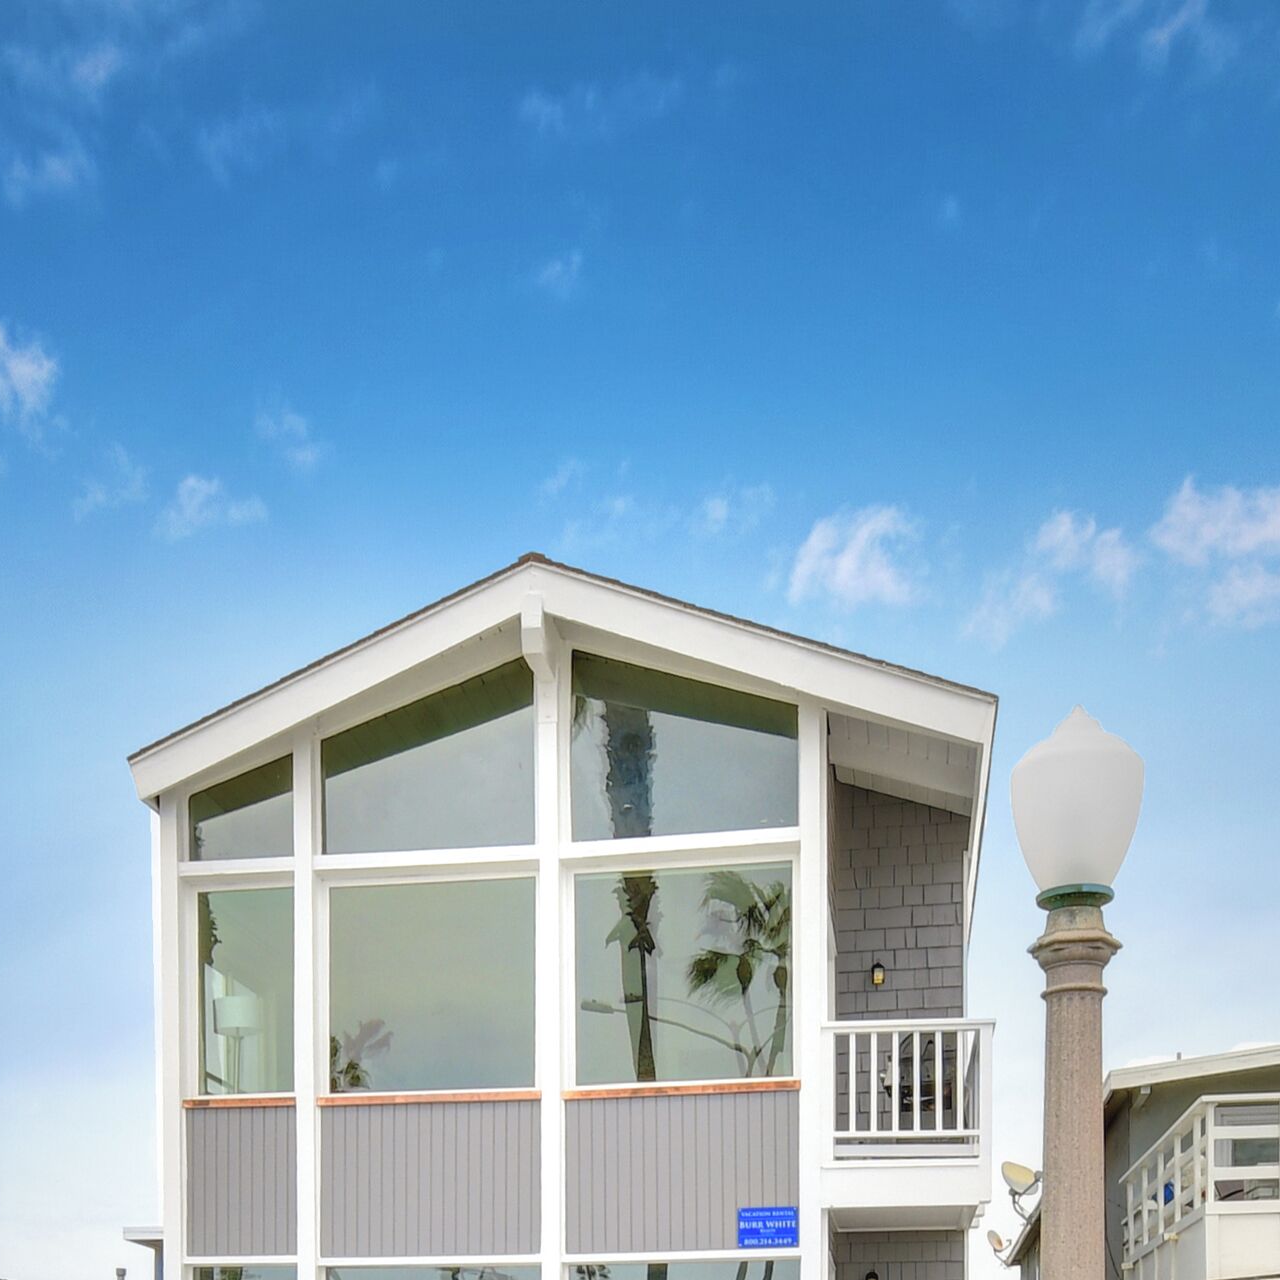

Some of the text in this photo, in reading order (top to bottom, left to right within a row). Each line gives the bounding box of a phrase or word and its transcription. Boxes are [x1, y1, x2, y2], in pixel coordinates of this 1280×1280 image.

[739, 1220, 796, 1229] BURR WHITE
[743, 1237, 793, 1246] 800.214.3449
